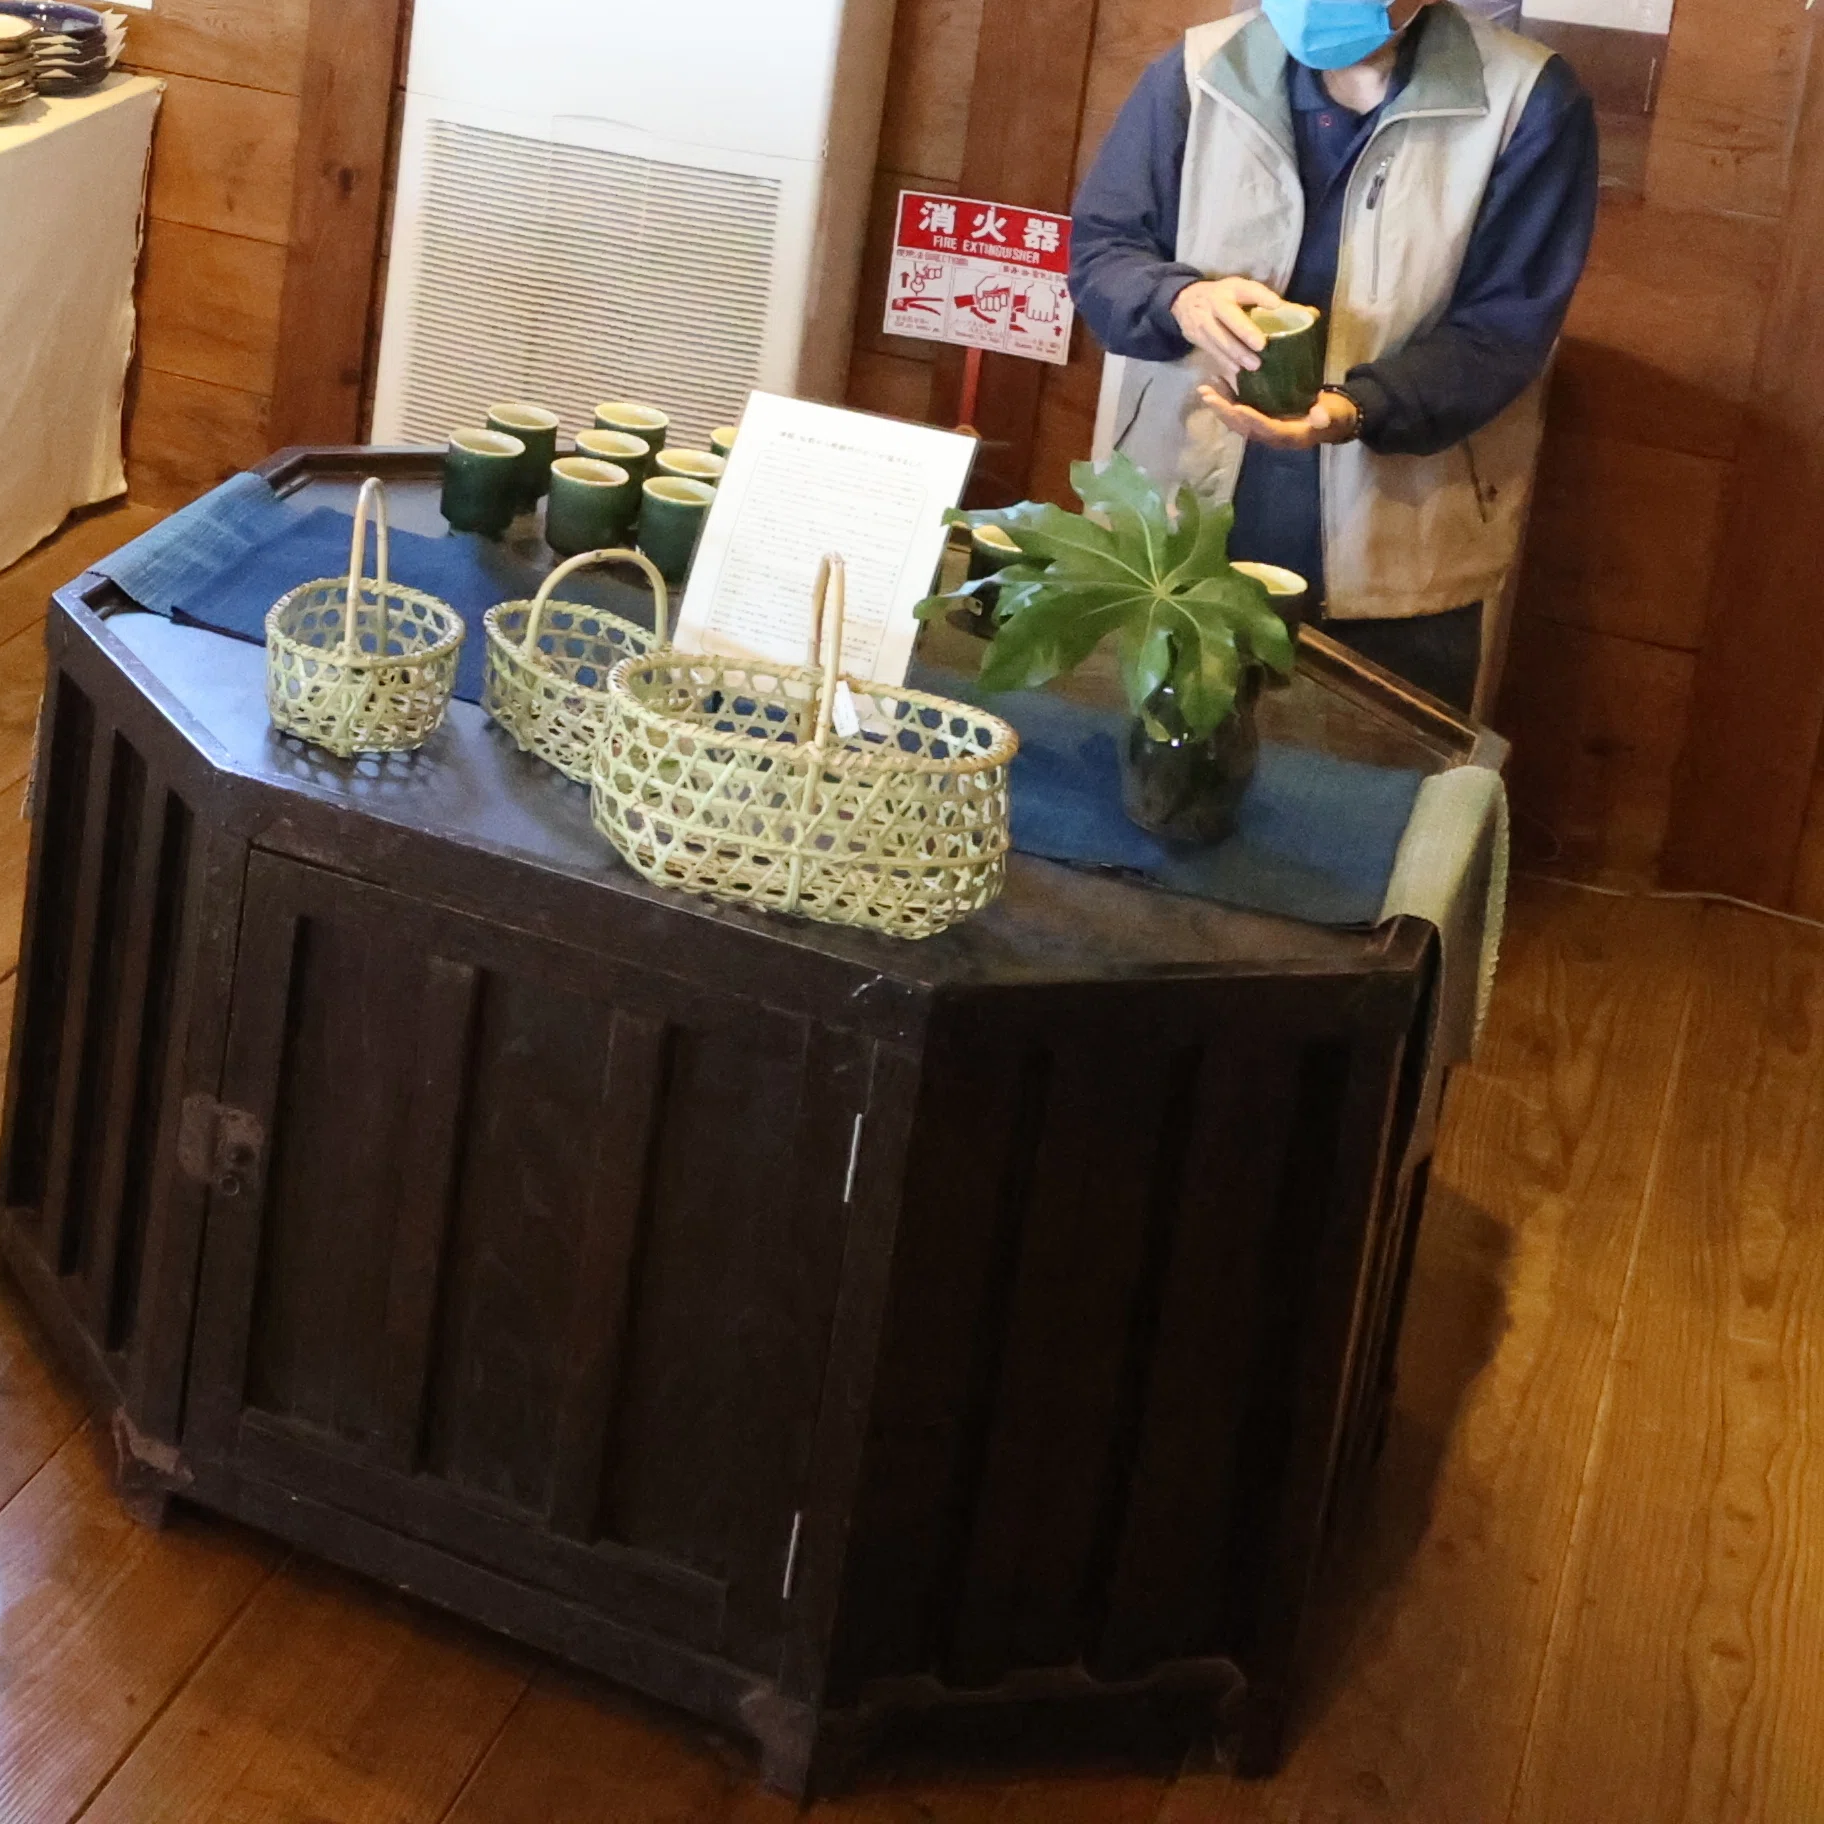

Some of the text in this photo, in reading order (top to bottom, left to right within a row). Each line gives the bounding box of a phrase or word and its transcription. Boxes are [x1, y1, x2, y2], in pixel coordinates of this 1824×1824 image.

[918, 201, 1060, 253] 消火器
[933, 235, 1041, 264] FIRE EXTINGUISHER
